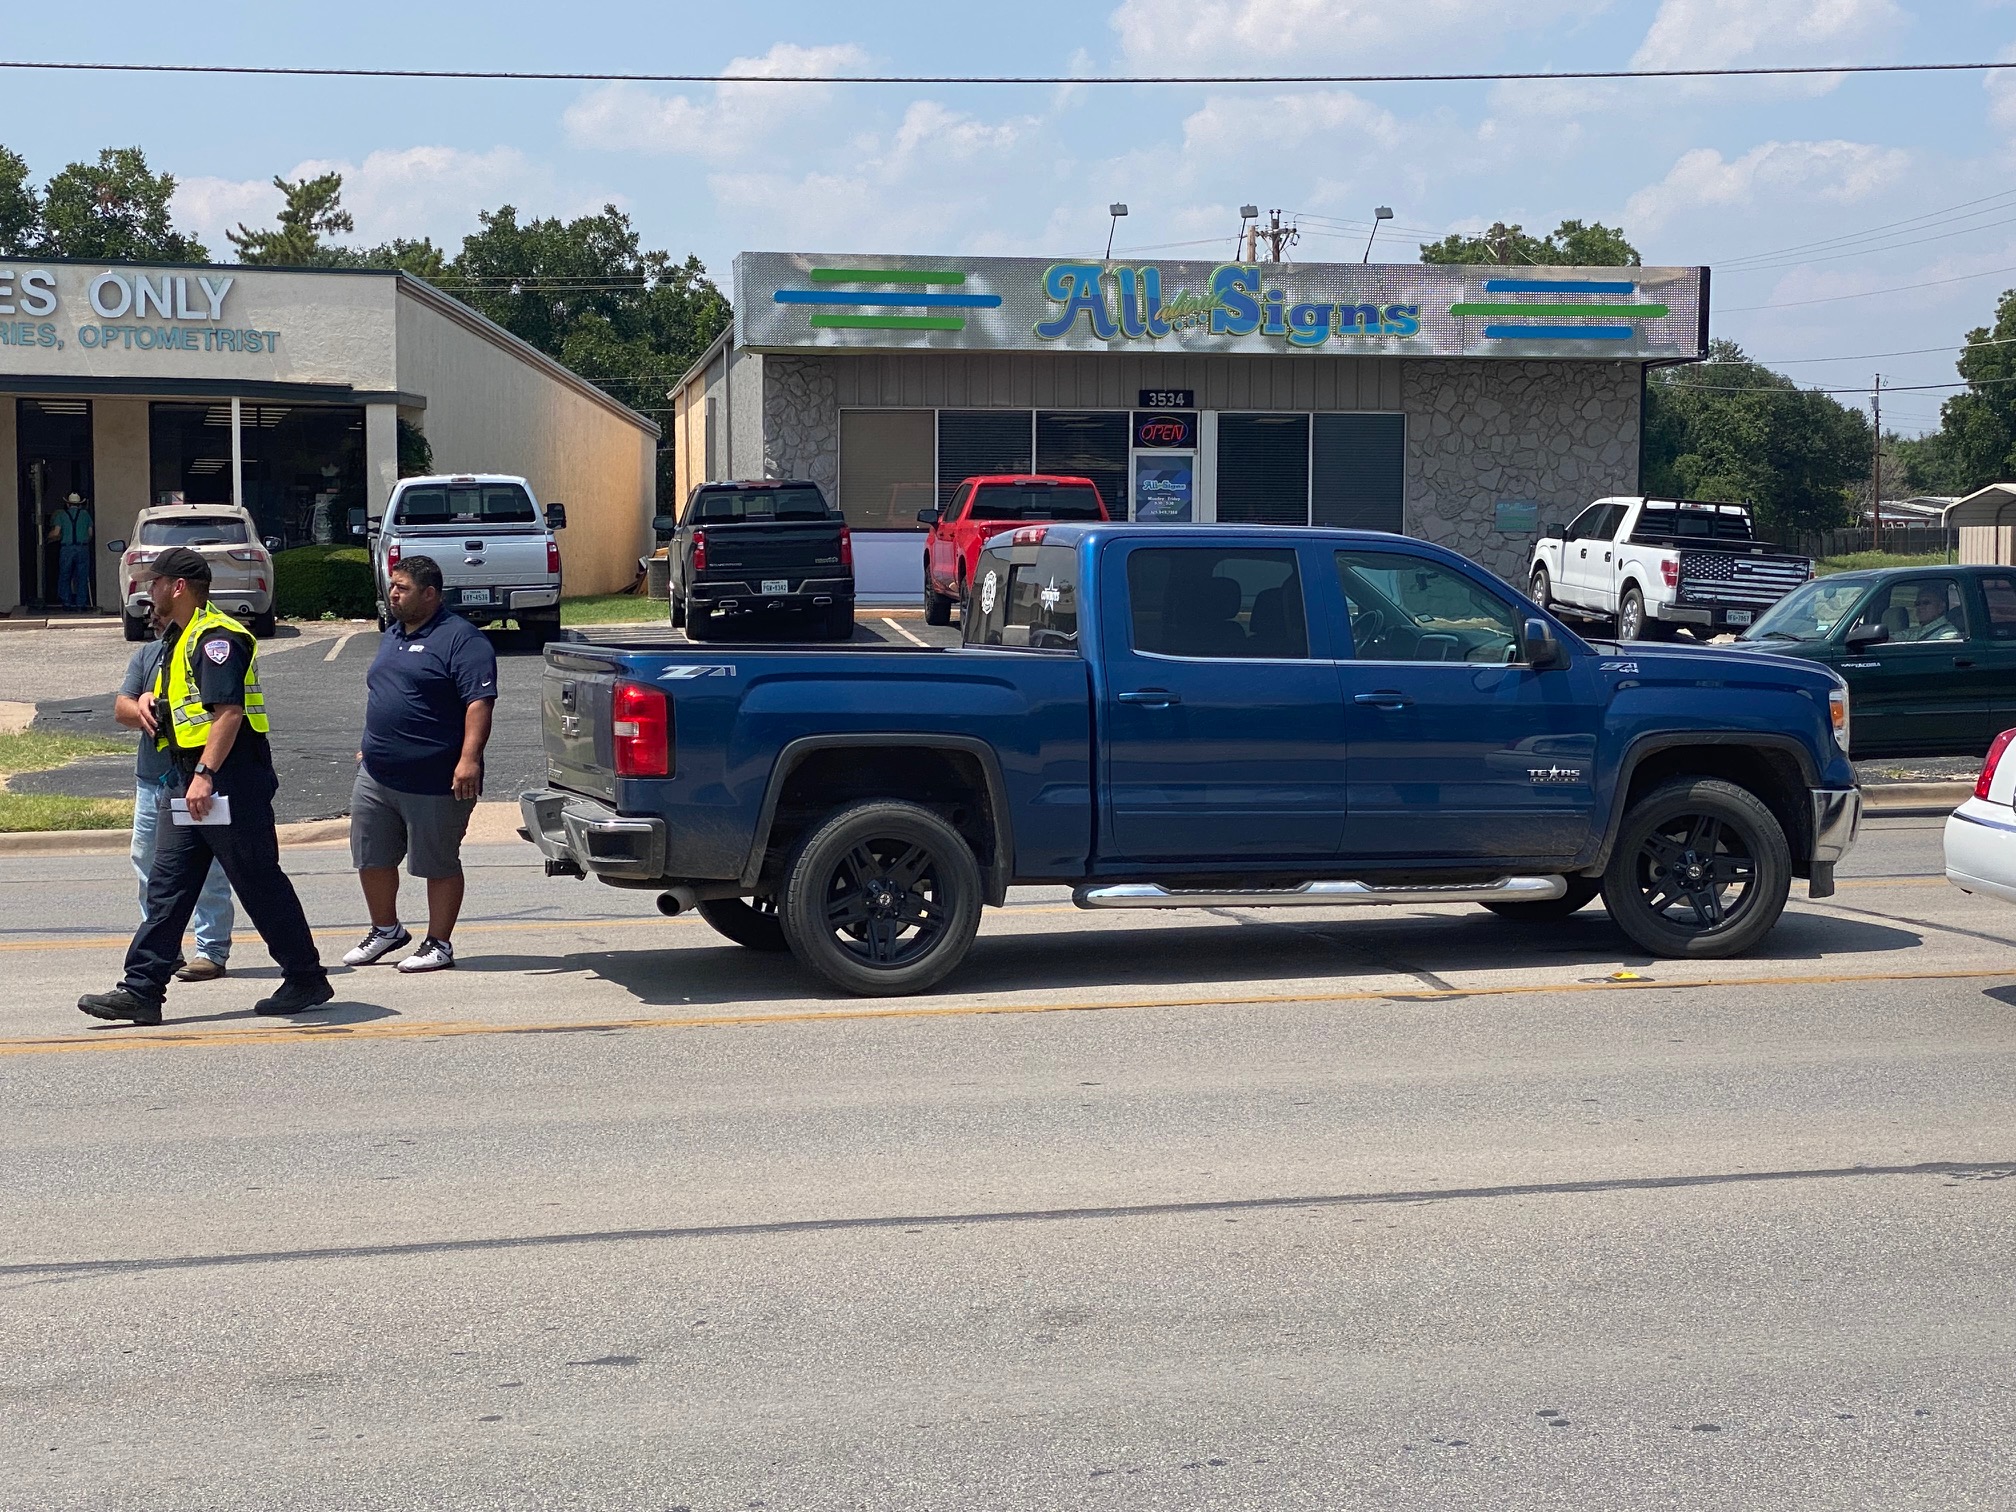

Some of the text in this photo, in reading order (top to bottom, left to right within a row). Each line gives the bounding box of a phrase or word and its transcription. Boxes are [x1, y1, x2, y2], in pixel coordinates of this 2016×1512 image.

[89, 270, 234, 320] ONLY
[1034, 263, 1173, 340] All
[1210, 265, 1421, 347] Signs
[78, 325, 281, 353] OPTOMETRIST
[1149, 393, 1184, 406] 3534
[1141, 424, 1184, 440] OPEN
[657, 664, 737, 680] Z71
